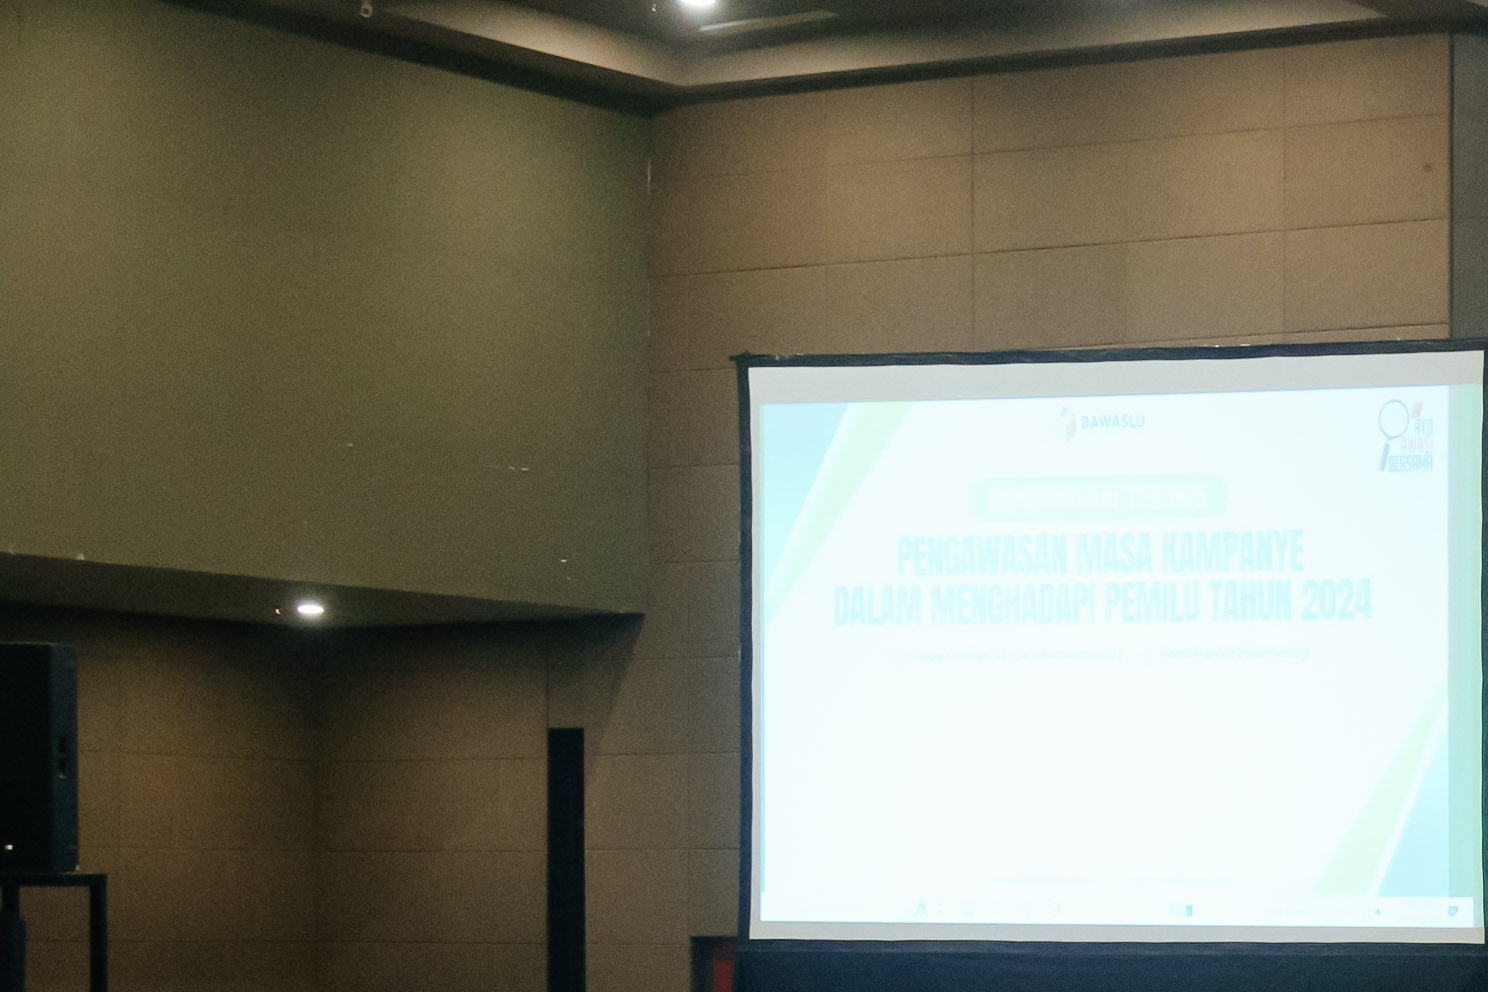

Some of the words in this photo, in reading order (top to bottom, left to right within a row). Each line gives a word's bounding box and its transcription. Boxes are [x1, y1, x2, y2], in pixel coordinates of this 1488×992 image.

[1081, 413, 1145, 428] BAWASLU
[897, 533, 1068, 576] PENGAWASAN
[1077, 532, 1153, 575] MASA
[1162, 529, 1305, 573] KAMPANYE
[833, 583, 922, 627] DALAM
[930, 582, 1096, 625] MENGHADAPI
[1105, 580, 1201, 623] PEMILU
[1209, 578, 1292, 622] TAHUN
[1302, 576, 1373, 621] 2024
